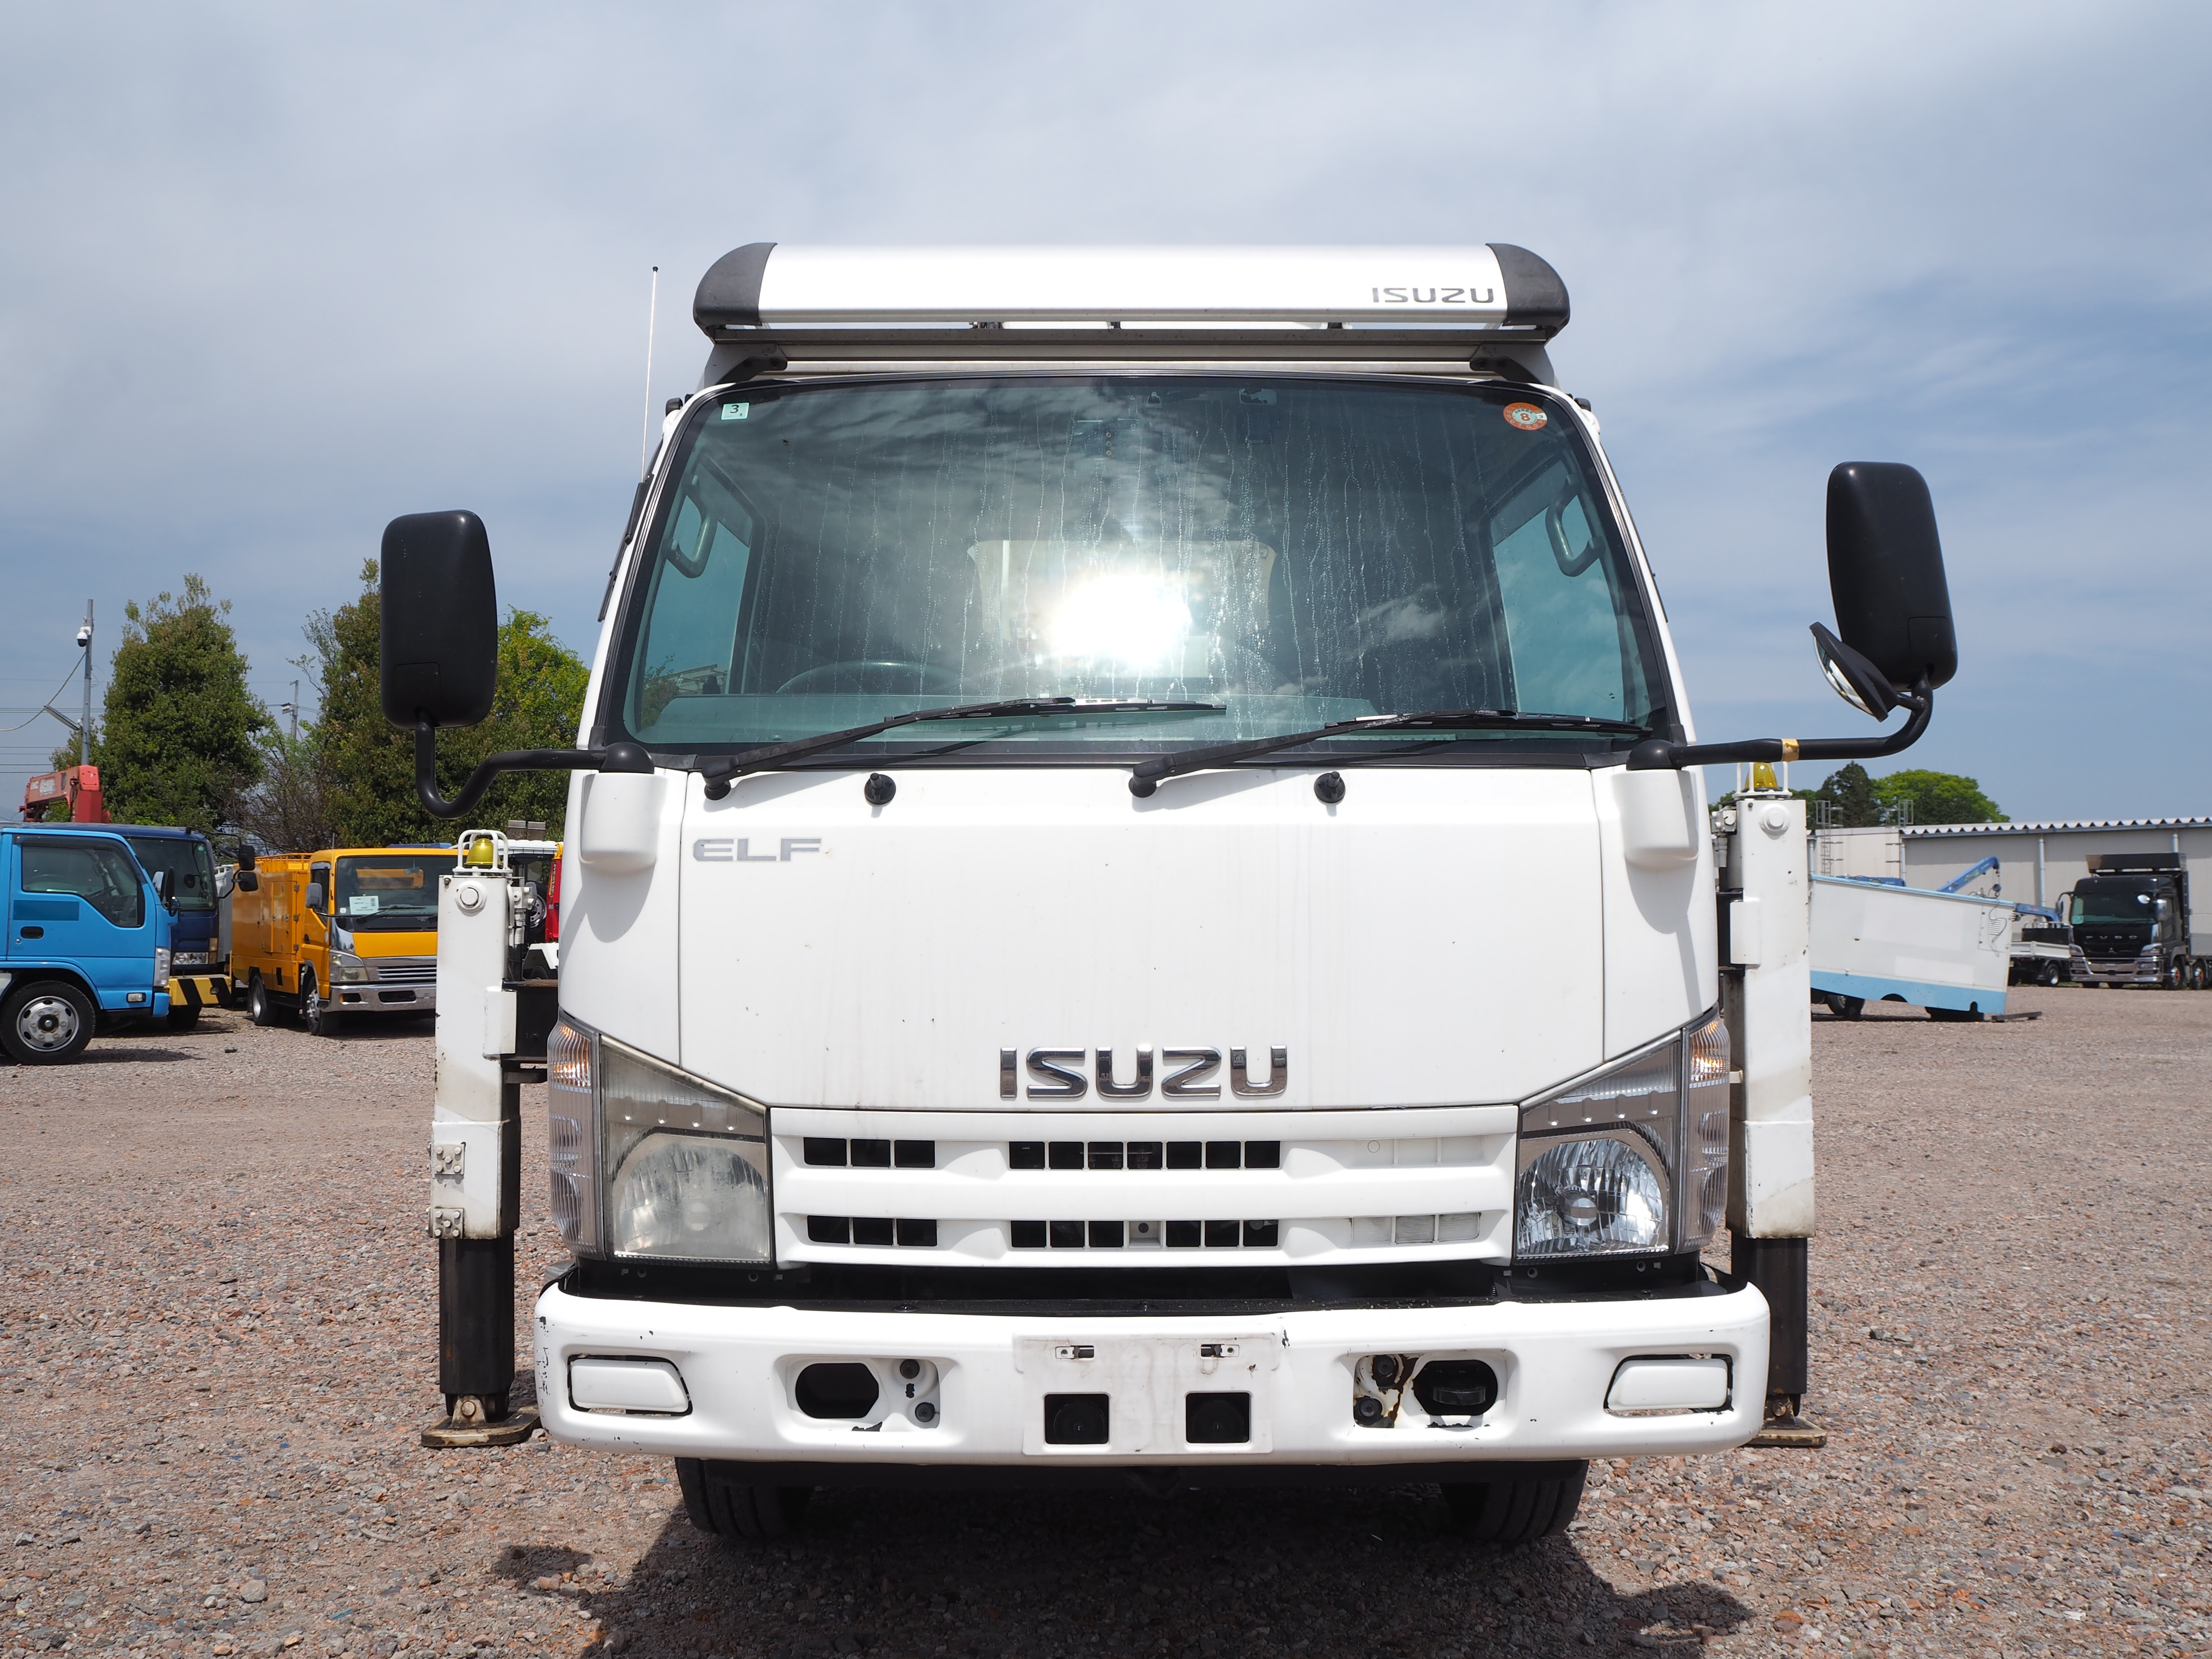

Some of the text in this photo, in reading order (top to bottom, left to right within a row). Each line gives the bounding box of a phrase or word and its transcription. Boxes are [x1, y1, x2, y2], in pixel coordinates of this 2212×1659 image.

[1372, 288, 1494, 303] ISUZU
[730, 405, 739, 413] 3
[693, 838, 821, 862] ELF
[1000, 1046, 1288, 1098] ISUZU
